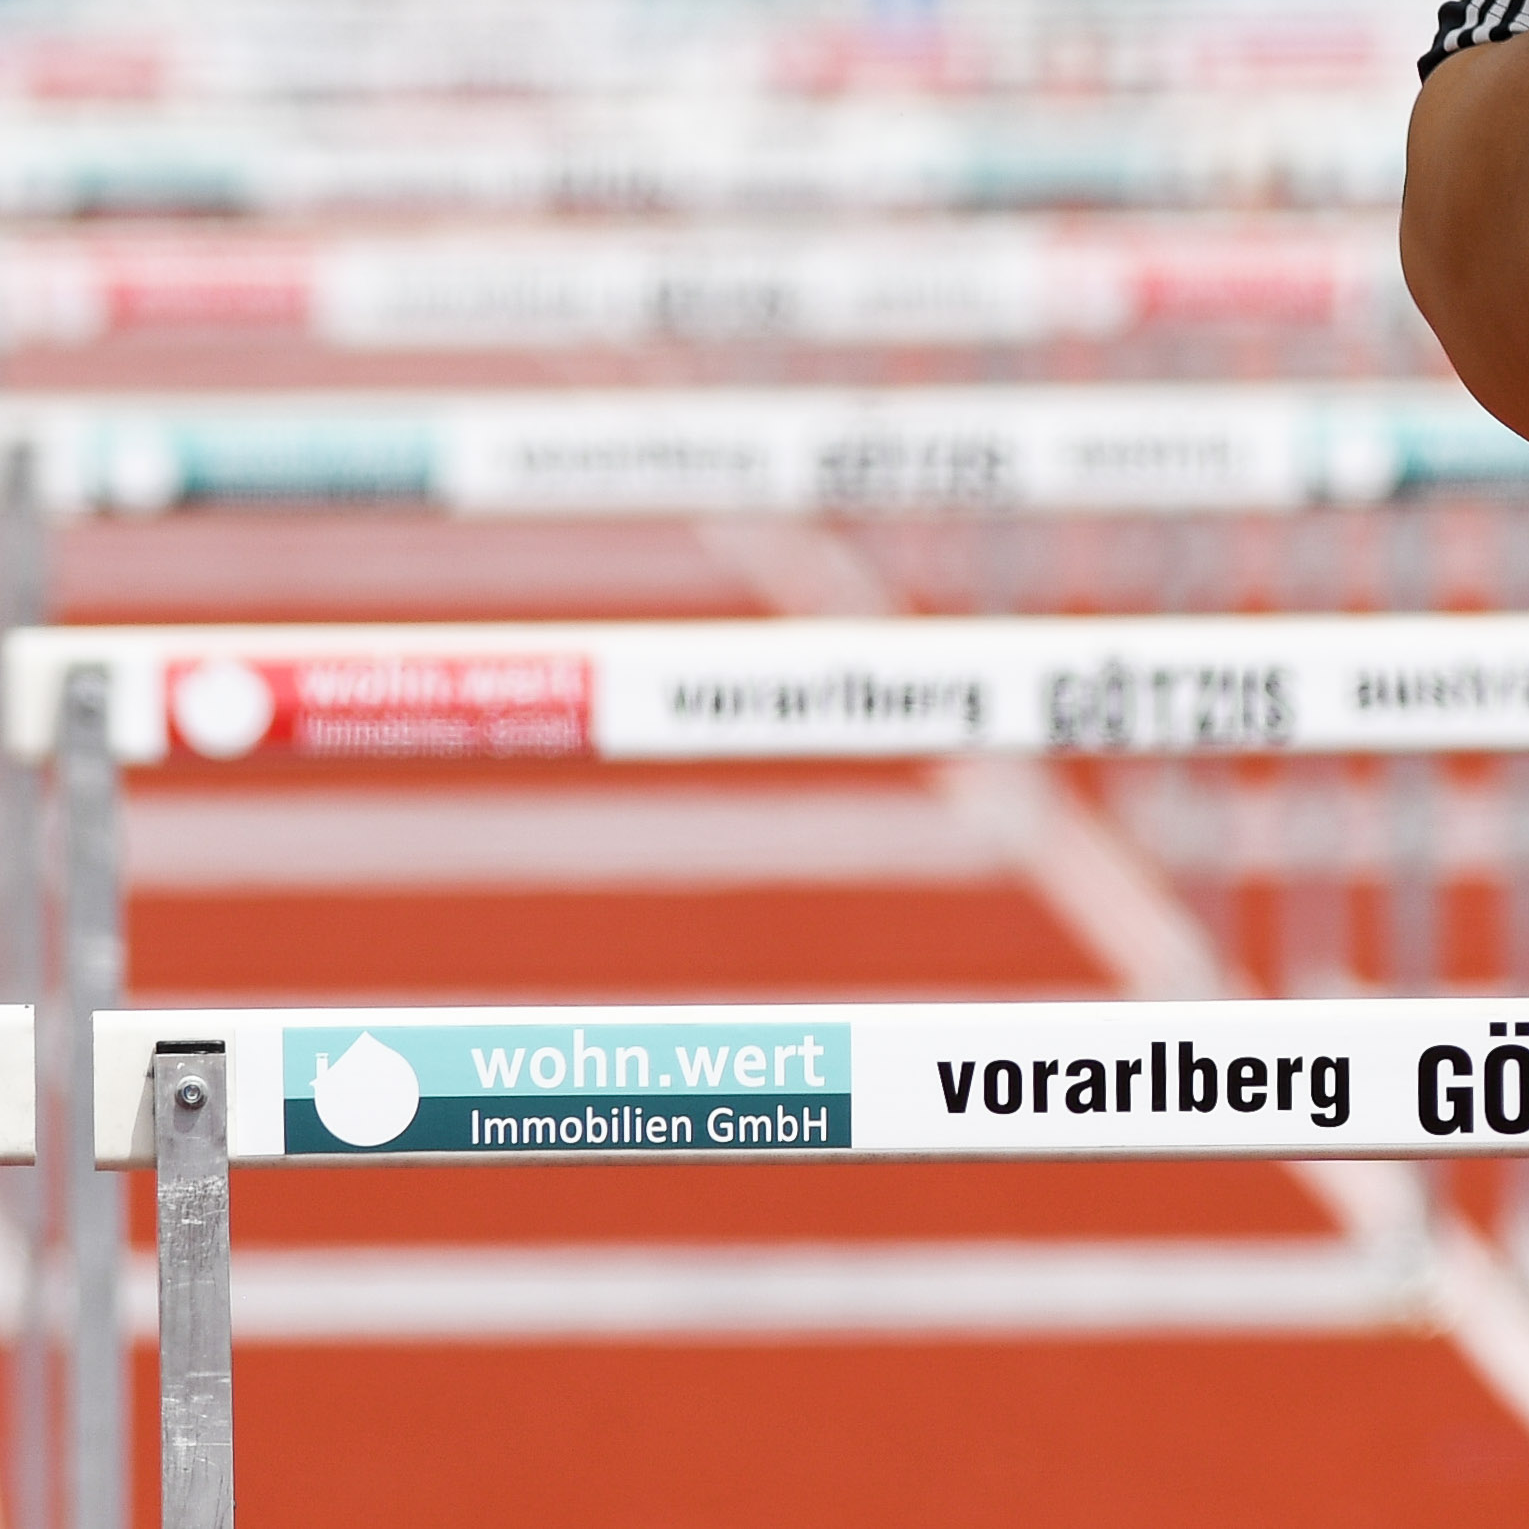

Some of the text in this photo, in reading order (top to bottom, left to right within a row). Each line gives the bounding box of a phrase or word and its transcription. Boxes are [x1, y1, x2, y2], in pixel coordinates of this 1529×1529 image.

[470, 1034, 826, 1091] wohn.wert
[936, 1041, 1351, 1127] vorarlberg
[470, 1106, 828, 1146] Immobilien GmbH
